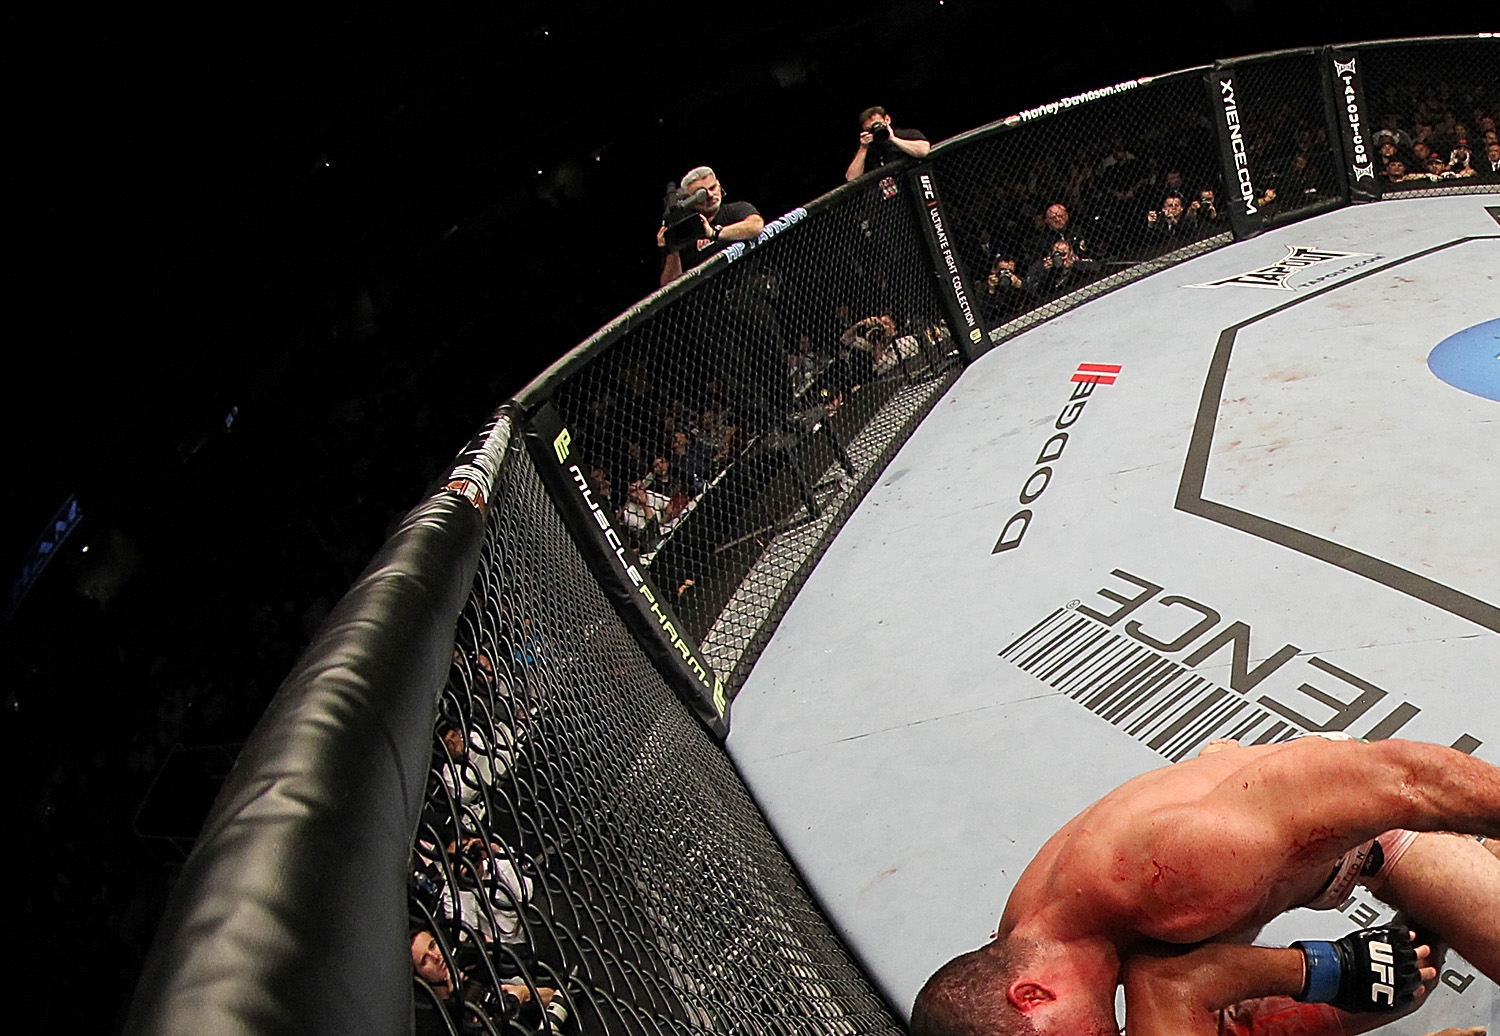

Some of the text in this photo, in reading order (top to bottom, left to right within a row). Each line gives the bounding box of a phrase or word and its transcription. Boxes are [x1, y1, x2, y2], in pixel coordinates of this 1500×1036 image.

[1220, 79, 1257, 215] XYIENCE.COM
[1342, 75, 1368, 164] TAPOUT.COM
[920, 175, 935, 199] UFC
[930, 208, 949, 250] ULTIMATE
[942, 250, 958, 275] FIGHT
[951, 276, 976, 328] COLLECTION
[1178, 245, 1378, 291] TAPOUT
[991, 374, 1099, 555] DODGE
[1368, 940, 1394, 1007] UFC
